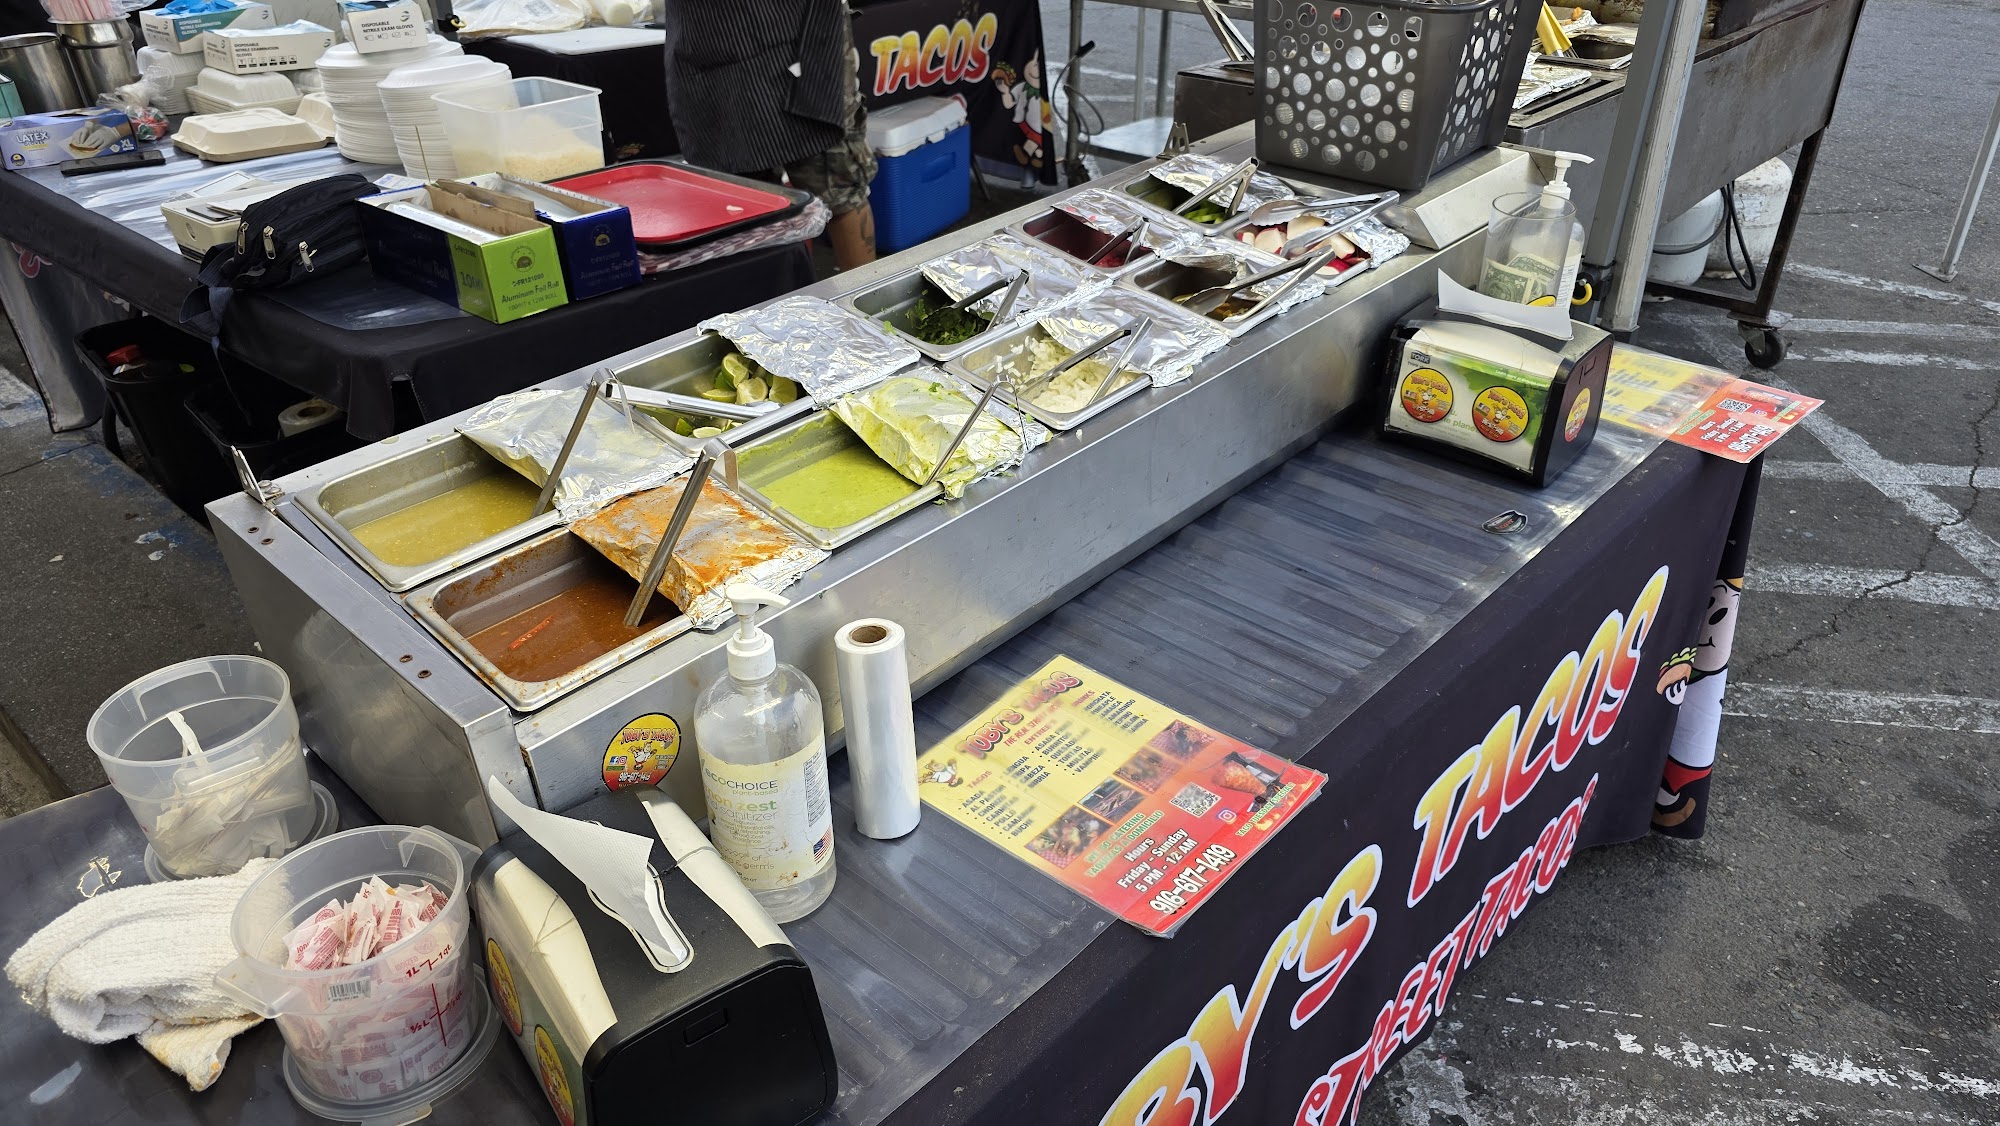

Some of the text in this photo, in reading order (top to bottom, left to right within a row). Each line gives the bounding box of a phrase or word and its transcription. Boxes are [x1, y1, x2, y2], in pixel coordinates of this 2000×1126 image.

[870, 12, 998, 97] TACOS
[16, 131, 49, 144] LATEX
[120, 138, 135, 148] XL
[502, 280, 560, 304] Aluminum Foil Roll
[1411, 352, 1430, 364] TORK
[1101, 700, 1122, 718] AMAICA
[1107, 699, 1136, 721] AMARINDO
[1114, 711, 1133, 726] EPINO
[956, 708, 1024, 760] TOBY'S
[1003, 735, 1017, 747] THE
[1034, 734, 1057, 752] ASADA
[1408, 564, 1669, 908] TACOS
[1058, 745, 1083, 764] TORTAS
[1074, 747, 1106, 773] VAMPIR
[1003, 755, 1030, 775] ENGUA
[705, 768, 778, 791] ecoCHOICE
[966, 770, 992, 789] TACOS
[732, 788, 779, 796] plant-based
[962, 790, 986, 808] ASADA
[720, 808, 778, 822] sanitizer
[737, 800, 778, 812] zest
[970, 804, 981, 813] AL
[994, 809, 1016, 827] POLLO
[1109, 812, 1146, 841] CATERING
[1126, 810, 1164, 841] DOMICILIO
[1234, 822, 1254, 837] TACO
[1249, 801, 1276, 825] TUESDAY
[751, 854, 762, 862] of
[1116, 860, 1151, 889] Friday
[1151, 827, 1189, 858] Sunday
[1123, 837, 1155, 862] Hours
[743, 862, 775, 870] germs
[1134, 882, 1148, 893] 5
[1142, 868, 1165, 886] PM
[1165, 850, 1183, 866] 12
[1177, 838, 1199, 855] AM
[1149, 844, 1237, 914] 916-617-1419
[394, 955, 419, 972] IODIZED
[405, 966, 420, 978] 1L
[1293, 901, 1481, 1126] STREET
